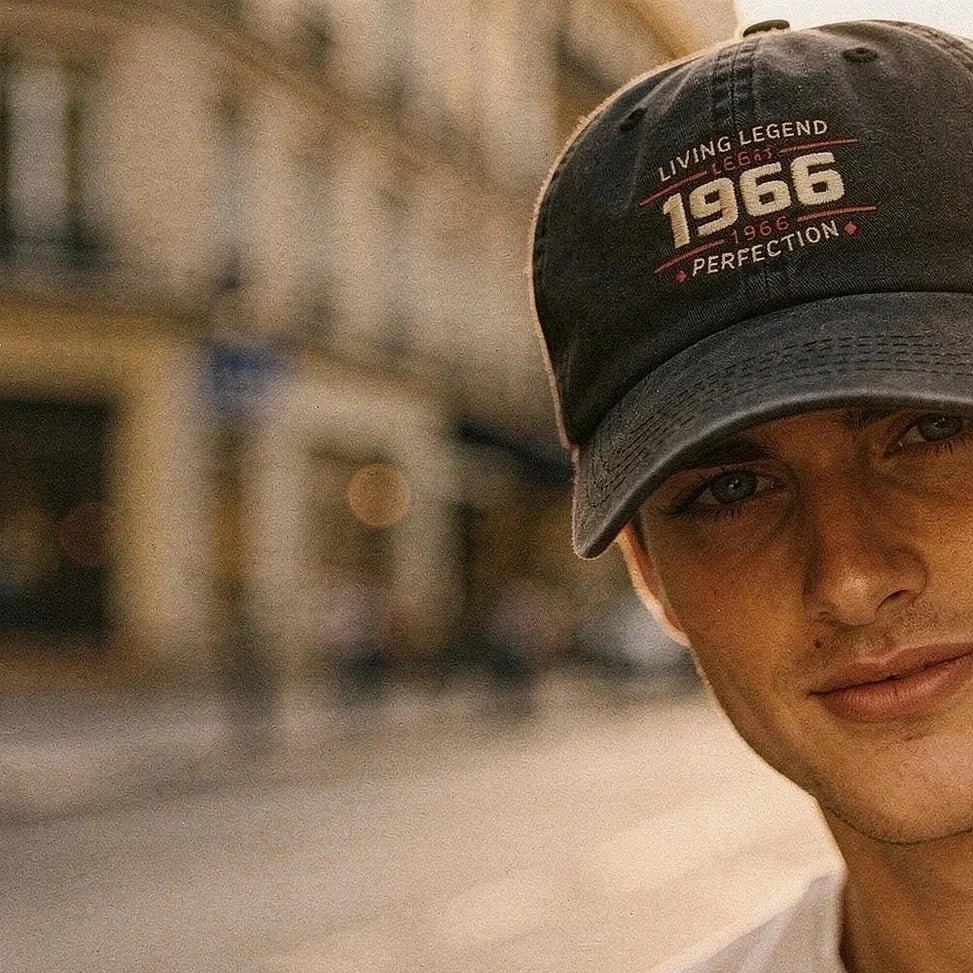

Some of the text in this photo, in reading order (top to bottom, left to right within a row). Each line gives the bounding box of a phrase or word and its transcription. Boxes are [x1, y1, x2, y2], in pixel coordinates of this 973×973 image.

[658, 119, 828, 182] LIVING LEGEND
[662, 151, 845, 249] 1966
[731, 215, 790, 244] 1966
[692, 219, 840, 277] PERFECTION
